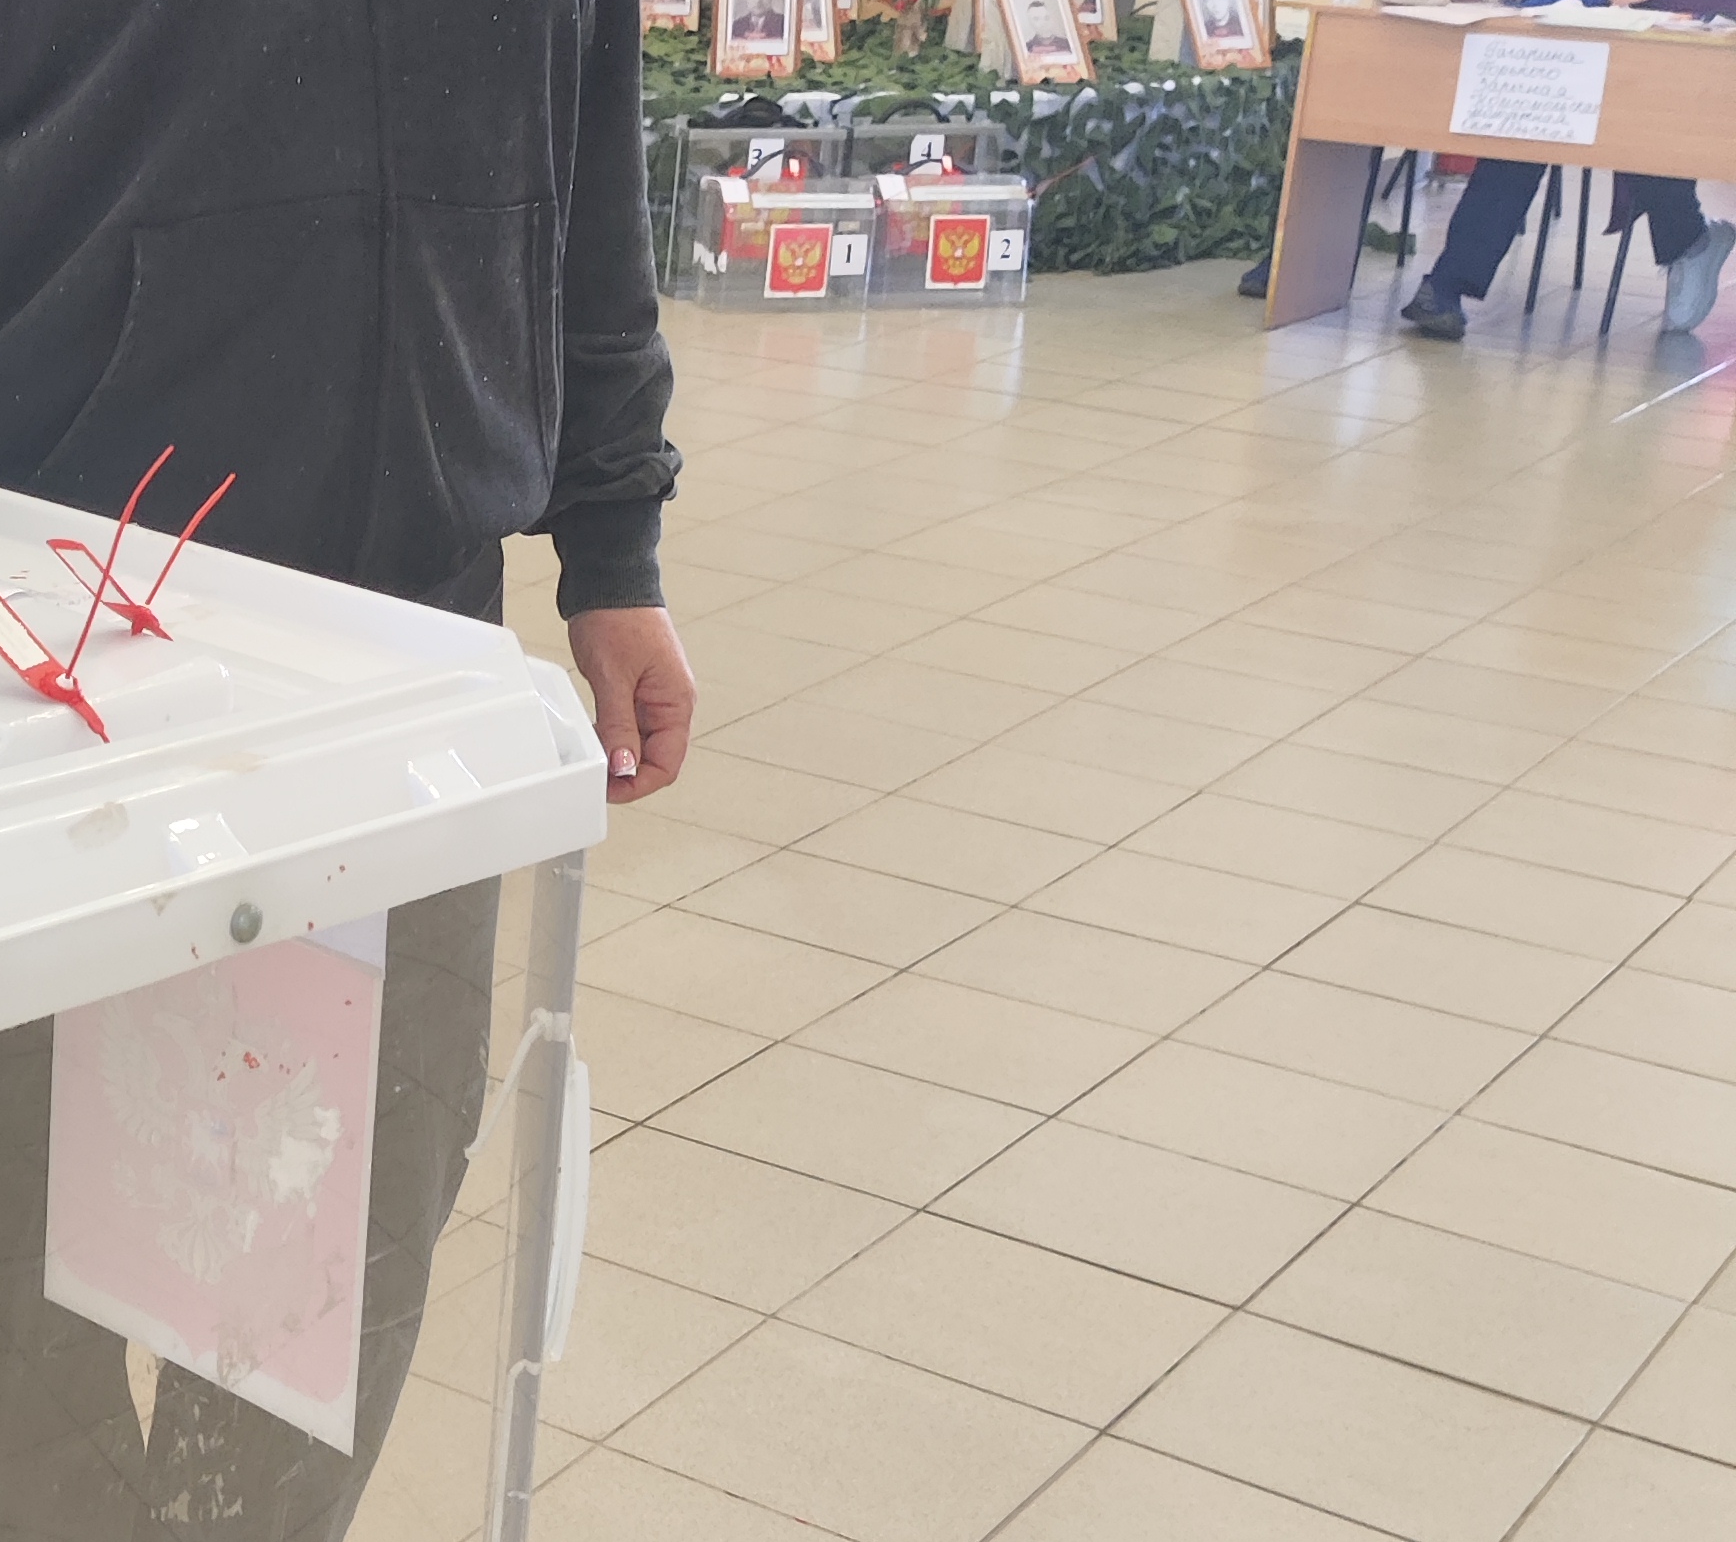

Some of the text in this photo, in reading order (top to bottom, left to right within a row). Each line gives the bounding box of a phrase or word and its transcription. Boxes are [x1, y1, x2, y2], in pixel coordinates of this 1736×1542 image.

[920, 142, 933, 159] 4
[844, 243, 853, 265] 1
[999, 238, 1012, 260] 2
